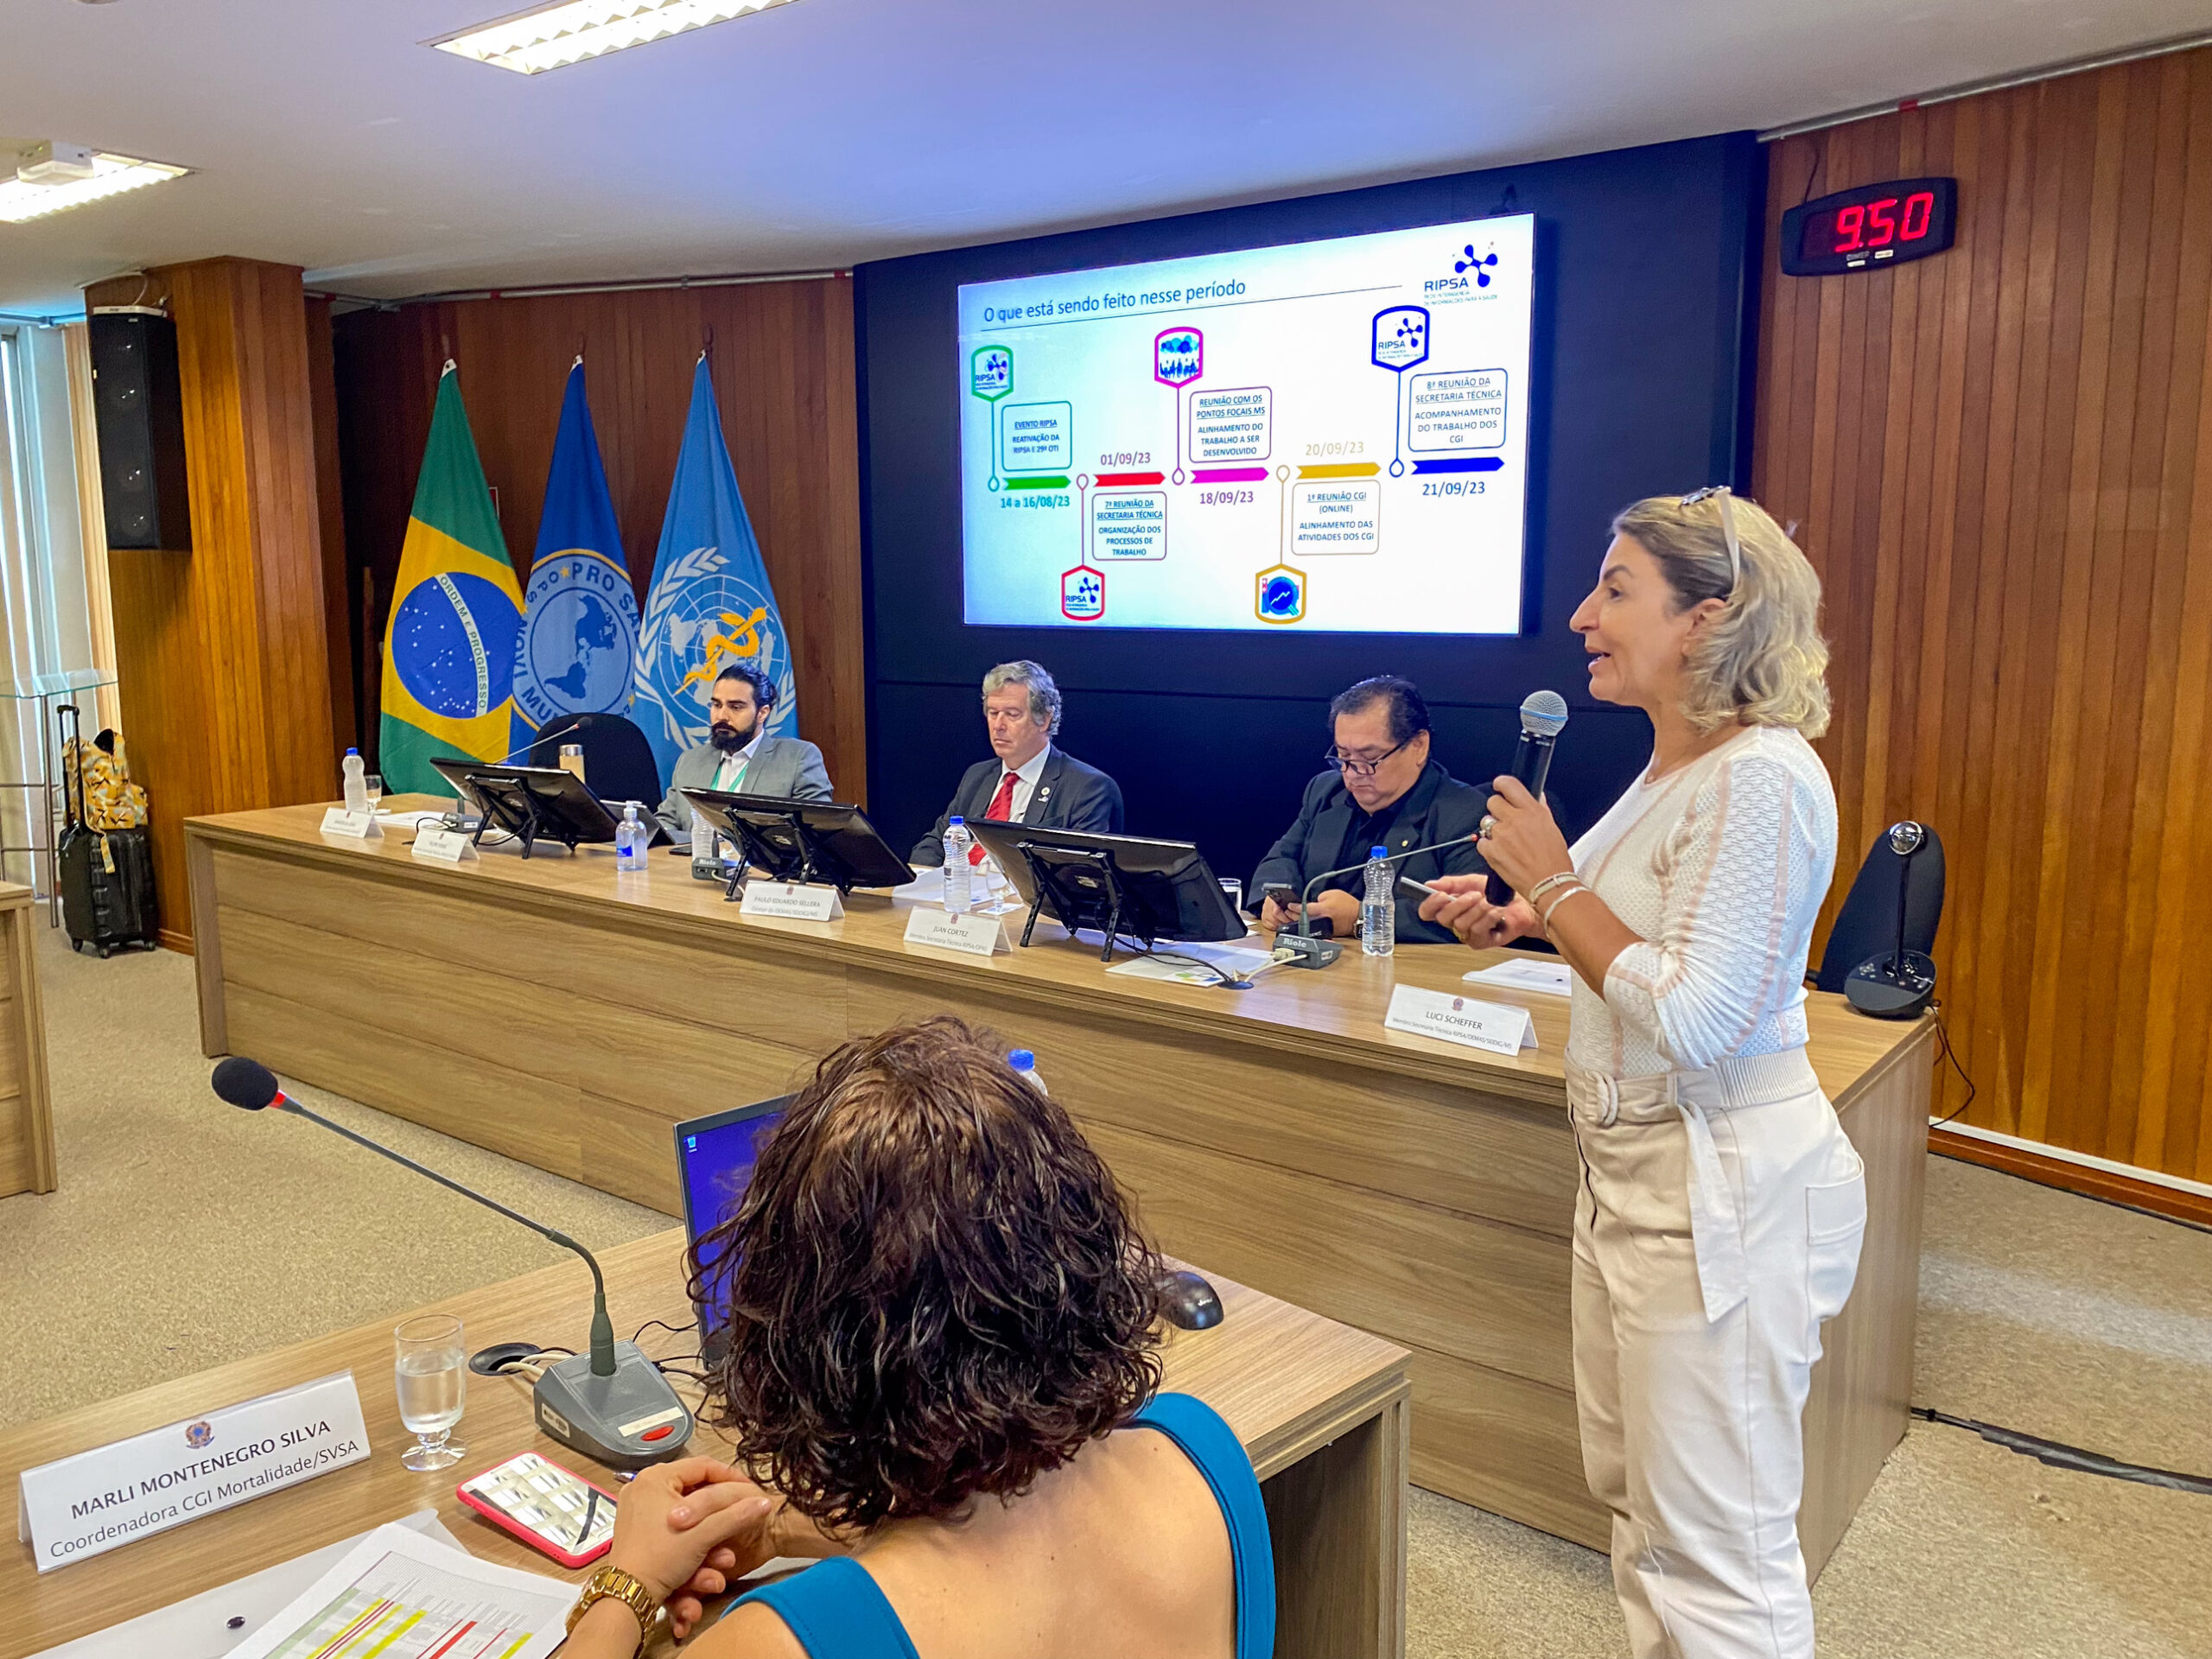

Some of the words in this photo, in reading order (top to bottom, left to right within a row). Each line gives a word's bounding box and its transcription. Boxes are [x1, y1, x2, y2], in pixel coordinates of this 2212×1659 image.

[1424, 277, 1469, 292] RIPSA
[984, 308, 995, 322] O
[998, 305, 1022, 324] que
[1027, 299, 1053, 318] está
[1058, 295, 1099, 315] sendo
[1102, 291, 1135, 309] feito
[1141, 288, 1181, 305] nesse
[1186, 278, 1246, 304] período
[1377, 340, 1406, 350] RIPSA
[976, 373, 995, 382] RIPSA
[1438, 377, 1477, 388] REUNIÃO
[1478, 377, 1491, 385] DA
[1199, 395, 1231, 406] REUNIÃO
[1233, 395, 1251, 404] COM
[1253, 394, 1262, 403] OS
[1415, 392, 1464, 403] SECRETARIA
[1466, 389, 1502, 400] TÉCNICA
[1196, 409, 1225, 418] PONTOS
[1227, 407, 1252, 416] FOCAIS
[1414, 407, 1502, 420] ACOMPANHAMENTO
[1014, 420, 1039, 429] EVENTO
[1039, 419, 1058, 428] RIPSA
[1198, 423, 1250, 434] ALINHAMENTO
[1433, 421, 1477, 431] TRABALHO
[1479, 420, 1497, 429] DOS
[1012, 433, 1050, 443] REATIVAÇÃO
[1201, 435, 1238, 445] TRABALHO
[1449, 435, 1464, 443] CGI
[1203, 447, 1257, 456] DESENVOLVIDO
[1306, 441, 1364, 457] 20/09/23
[1100, 451, 1151, 467] 01/09/23
[1422, 480, 1485, 498] 21/09/23
[1199, 490, 1254, 505] 18/09/23
[1317, 491, 1352, 501] REUNIÃO
[1353, 492, 1367, 500] CGI
[1001, 497, 1012, 508] 14
[1014, 499, 1020, 507] a
[1023, 495, 1071, 510] 16/08/23
[1114, 499, 1143, 508] REUNIÃO
[1096, 512, 1135, 520] SECRETARIA
[1135, 509, 1163, 518] TÉCNICA
[1319, 505, 1353, 514] (ONLINE)
[1098, 524, 1146, 535] ORGANIZAÇÃO
[1300, 520, 1356, 530] ALINHAMENTO
[1343, 532, 1359, 541] DOS
[571, 563, 615, 593] PRO
[1065, 594, 1087, 603] RIPSA
[439, 576, 467, 618] ORDEM
[468, 631, 487, 709] PROGRESSO
[947, 928, 969, 938] CORTEZ
[1282, 938, 1307, 948] Riole
[1425, 1011, 1444, 1021] LUCI
[1444, 1014, 1483, 1030] SCHEFFER
[70, 1484, 135, 1519] MARLI
[141, 1438, 276, 1497] MONTENEGRO
[280, 1420, 332, 1448] SILVA
[50, 1503, 179, 1557] Coordenadora
[181, 1491, 213, 1512] CGI
[218, 1440, 359, 1499] Mortalidade/SVSA
